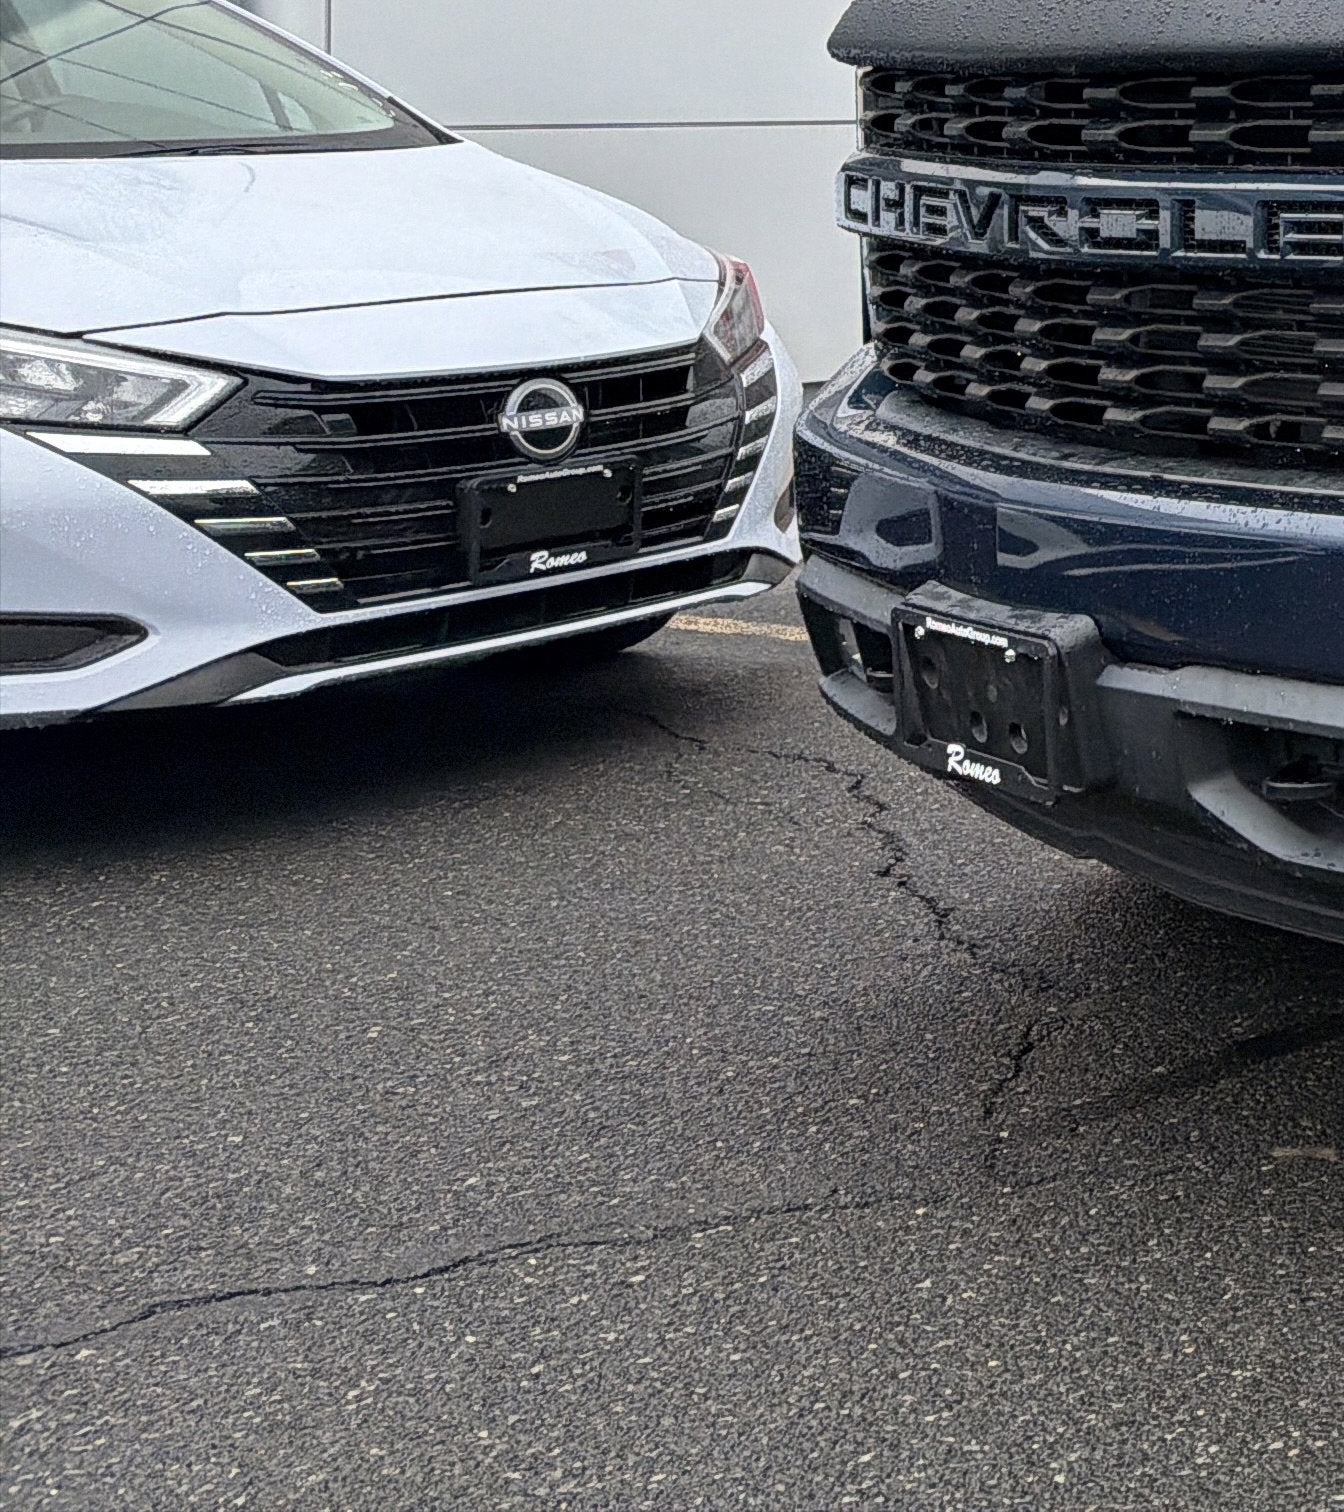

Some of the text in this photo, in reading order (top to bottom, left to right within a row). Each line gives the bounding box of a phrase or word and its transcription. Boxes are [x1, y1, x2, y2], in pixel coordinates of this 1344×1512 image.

[502, 408, 584, 430] NISSAN
[530, 550, 588, 573] Romeo
[947, 743, 1001, 784] Romeo
